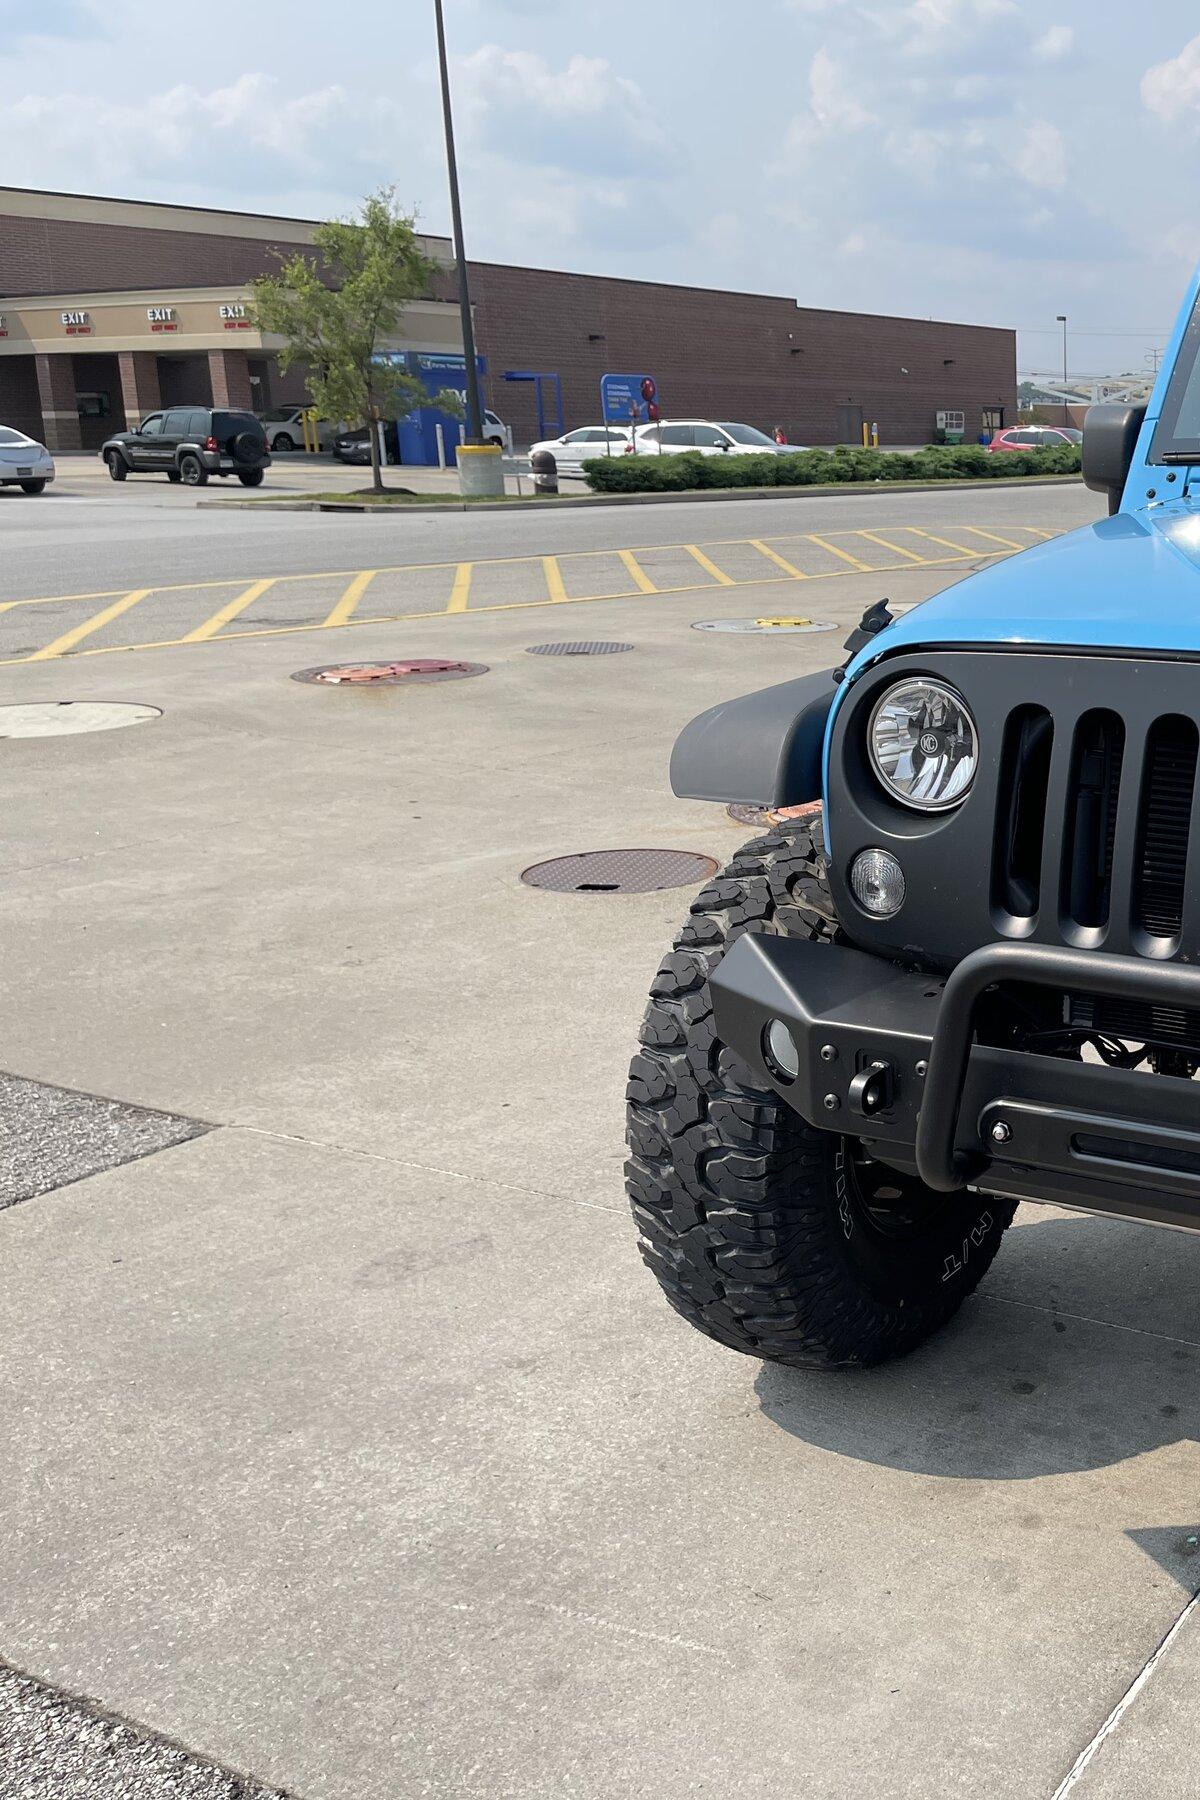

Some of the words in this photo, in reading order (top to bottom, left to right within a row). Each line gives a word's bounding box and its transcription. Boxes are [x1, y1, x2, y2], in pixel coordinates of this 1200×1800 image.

[61, 312, 85, 324] EXIT
[147, 308, 173, 321] EXIT
[219, 305, 245, 318] EXIT
[923, 735, 936, 751] KC
[941, 1210, 994, 1282] M/T
